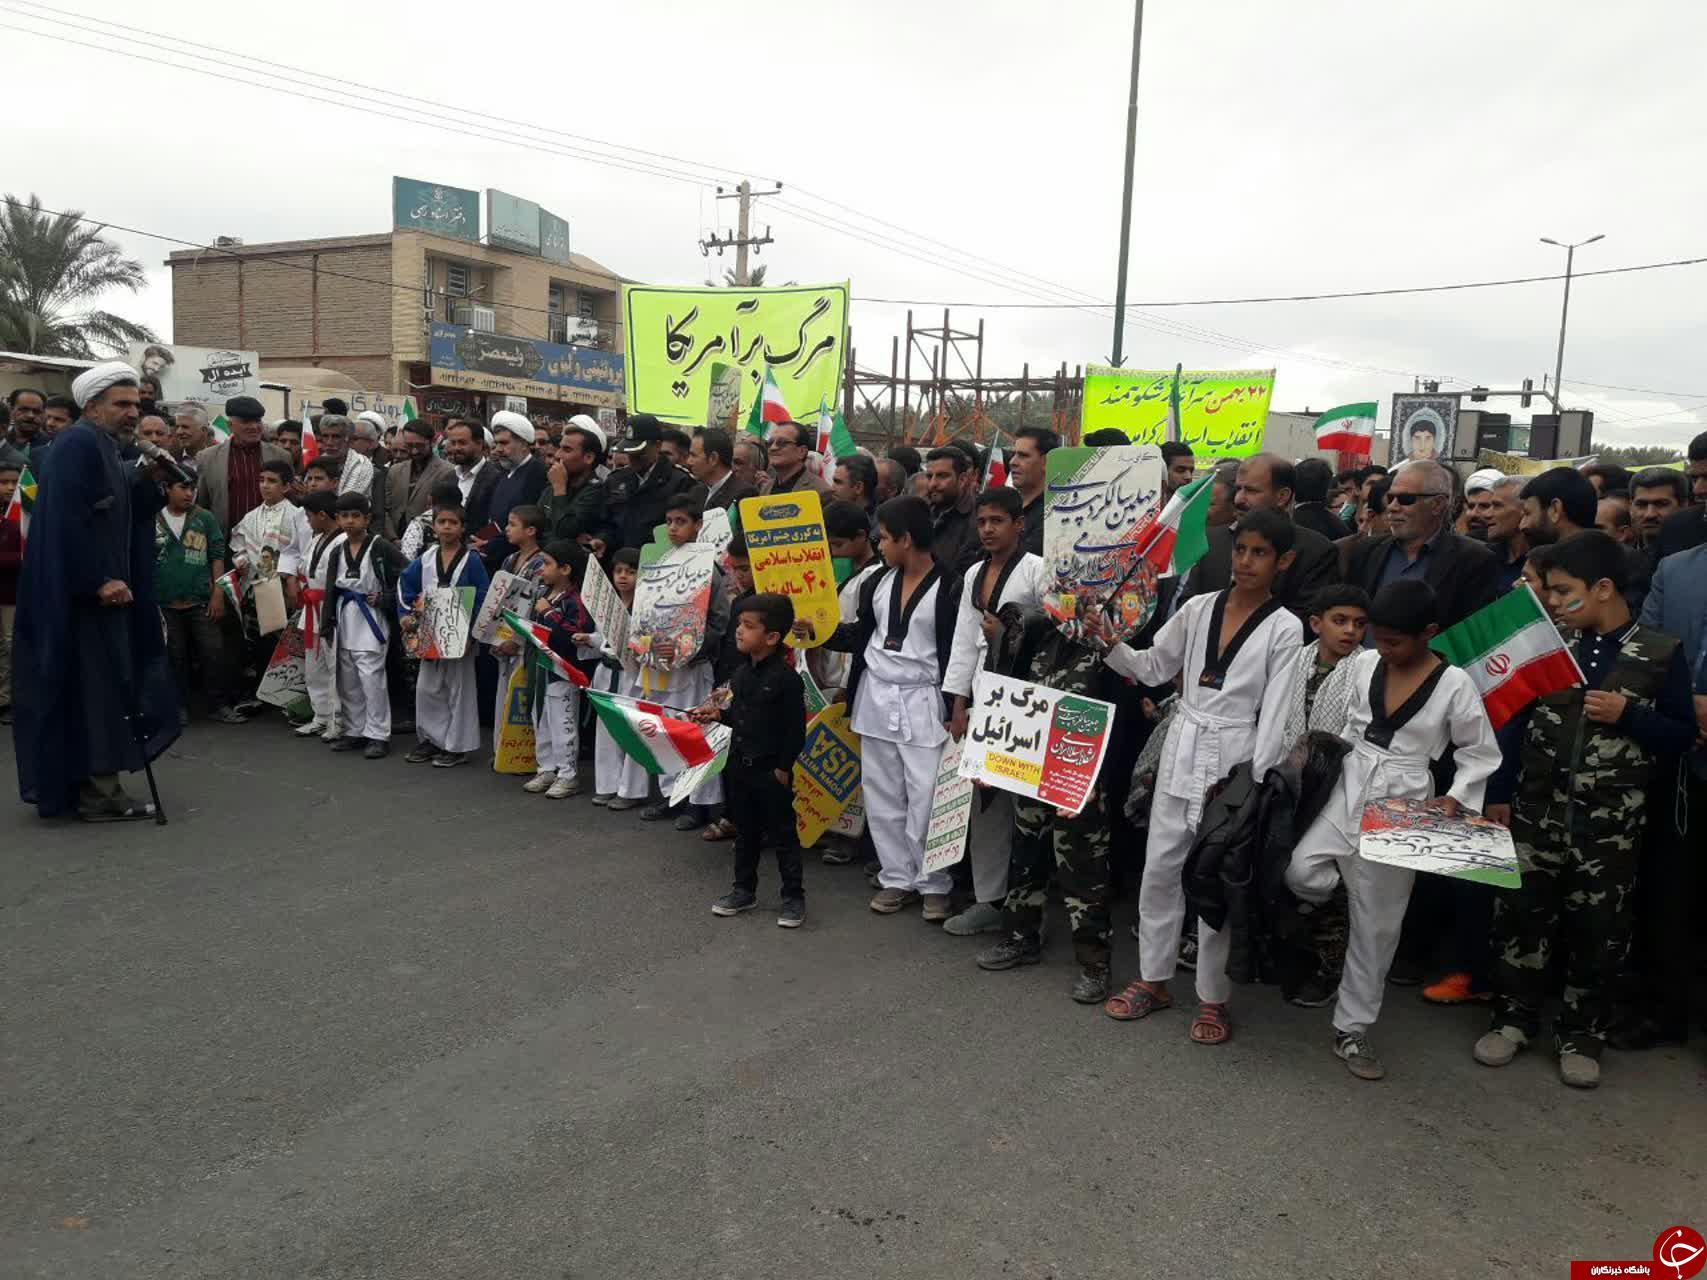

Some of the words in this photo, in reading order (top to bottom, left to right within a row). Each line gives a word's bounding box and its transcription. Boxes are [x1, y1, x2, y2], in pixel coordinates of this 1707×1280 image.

[665, 298, 760, 399] آمریکا
[763, 295, 836, 380] مرگ
[738, 334, 764, 385] بر
[1204, 386, 1248, 414] بهمن
[1249, 384, 1268, 400] ۲۲
[1206, 421, 1262, 454] انقلاب
[772, 530, 791, 543] چشم
[792, 527, 812, 543] کوری
[754, 551, 792, 572] اسلامی
[793, 546, 826, 566] انقلاب
[983, 686, 1004, 707] بر
[1010, 687, 1049, 717] مرگ
[972, 715, 1041, 753] اسرائیل
[811, 730, 860, 787] USA
[988, 753, 1017, 768] DOWN
[1018, 762, 1041, 775] WITH
[994, 765, 1026, 778] ISRAEL
[819, 773, 844, 796] DOWN
